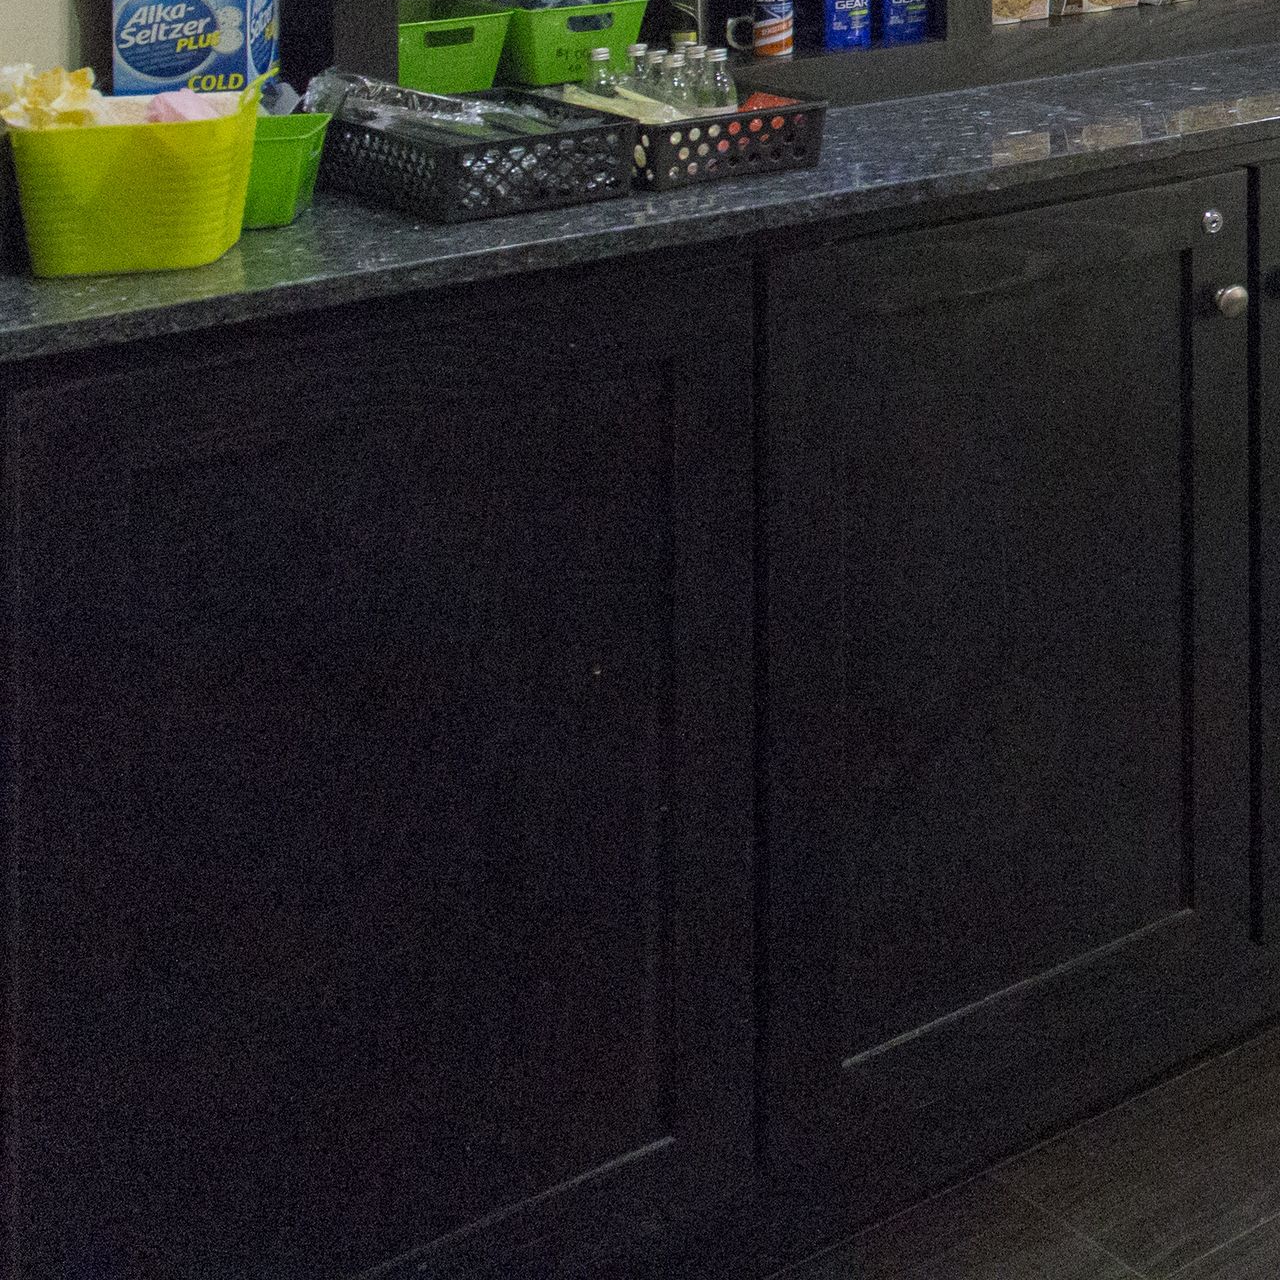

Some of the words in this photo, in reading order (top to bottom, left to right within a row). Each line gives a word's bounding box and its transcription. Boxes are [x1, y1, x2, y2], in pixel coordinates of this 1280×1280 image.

[124, 3, 195, 28] Alka-
[118, 17, 210, 49] Seltzer
[175, 31, 221, 53] PLUS
[187, 73, 244, 92] COLD
